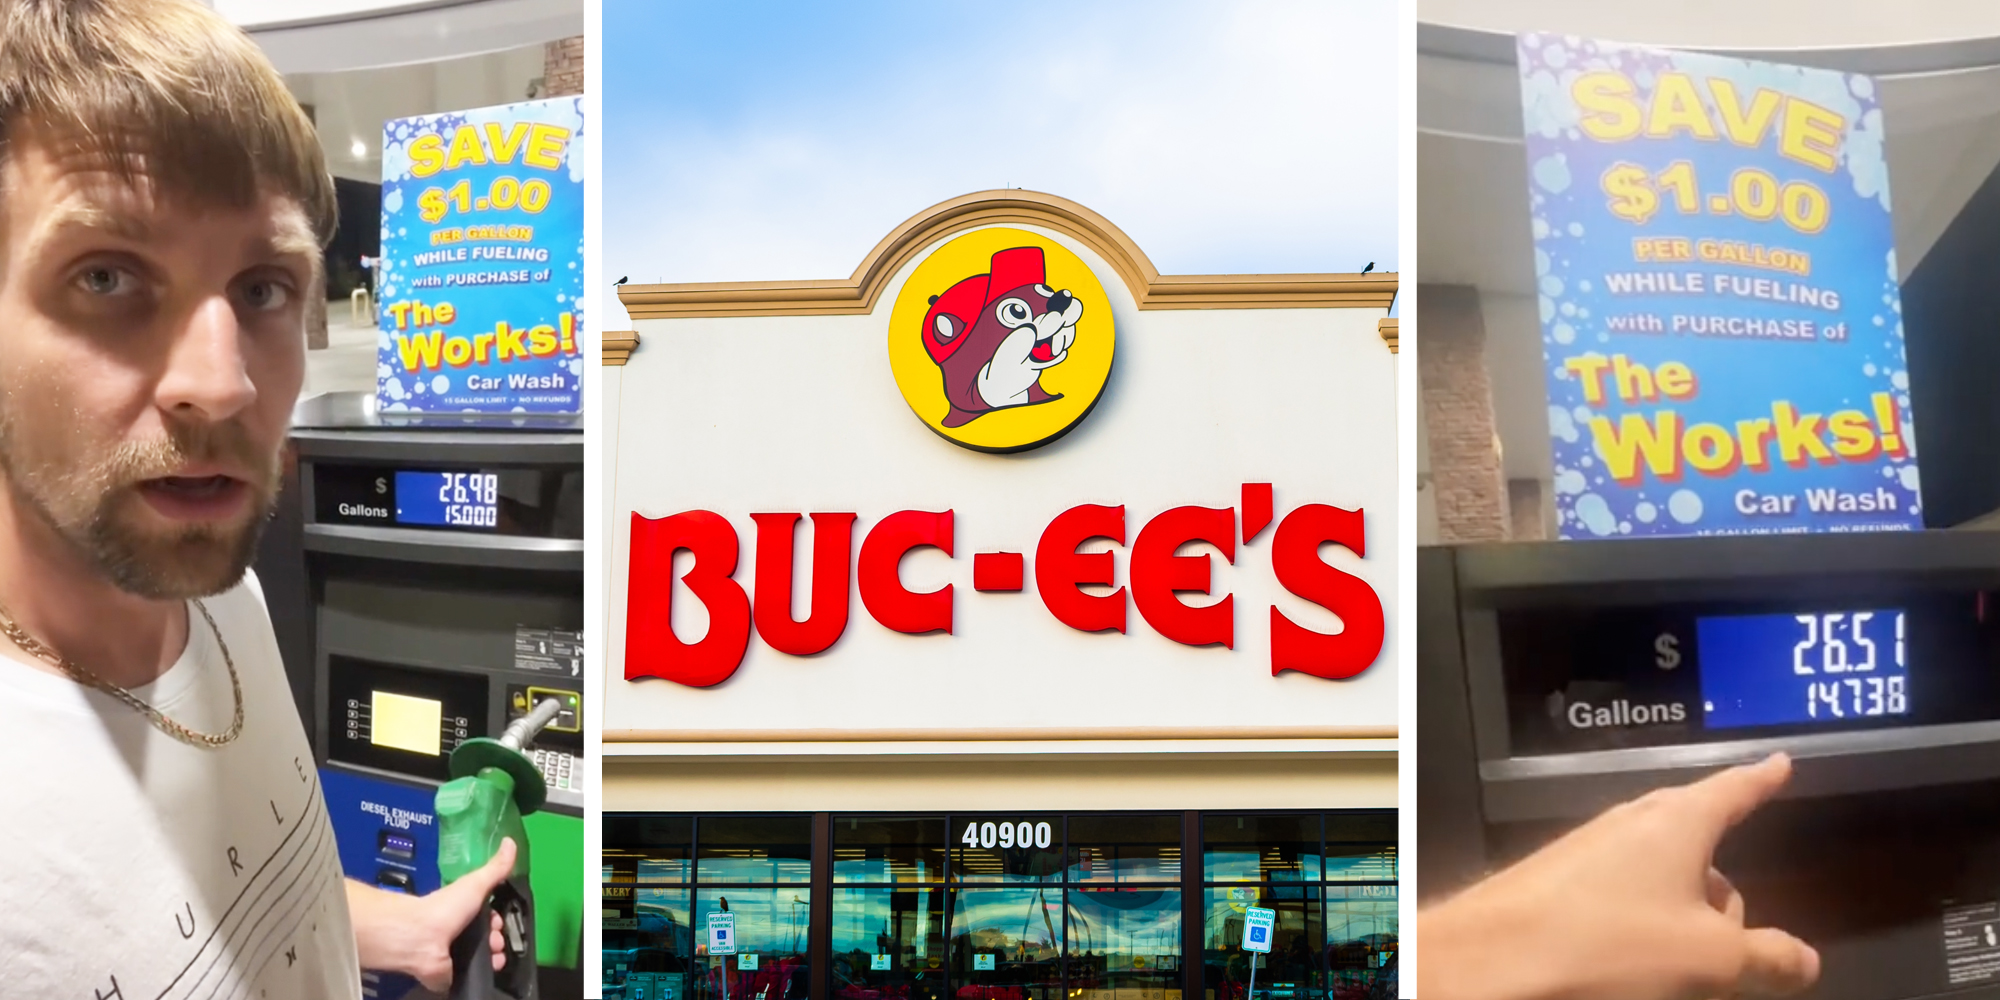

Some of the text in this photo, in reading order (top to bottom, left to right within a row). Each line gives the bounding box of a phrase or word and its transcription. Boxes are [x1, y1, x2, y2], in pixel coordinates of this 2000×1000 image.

[1569, 70, 1847, 173] SAVE
[408, 122, 571, 178] SAVE
[418, 177, 551, 223] $1.00
[1600, 161, 1830, 234] $1.00
[430, 224, 533, 245] PER GALLON
[413, 246, 549, 267] WHILE FUELING
[1633, 237, 1811, 275] PER GALLON
[411, 269, 551, 288] with PURCHASE of
[1605, 273, 1841, 311] WHILE FUELING
[389, 300, 456, 329] The
[1605, 313, 1847, 341] with PURCHASE of
[397, 312, 577, 373] Works!
[467, 373, 565, 391] Car Wash
[1565, 353, 1697, 405] The
[486, 396, 507, 404] LIMIT
[519, 396, 531, 404] NO
[533, 396, 572, 404] REFUNDS
[1587, 392, 1909, 487] Works!
[375, 477, 388, 494] $
[438, 471, 498, 505] 26.98
[338, 503, 388, 518] Gallons
[1735, 488, 1898, 515] Car Wash
[624, 483, 1385, 688] BUC-EE'S
[1654, 633, 1681, 670] $
[1793, 612, 1906, 676] 26.51
[1567, 699, 1687, 729] Gallons
[361, 801, 433, 826] DIESEL EXHAUST
[384, 813, 410, 829] FLUID
[962, 821, 1052, 849] 40900
[1247, 910, 1274, 920] RESERVED
[1248, 918, 1270, 927] PARKING
